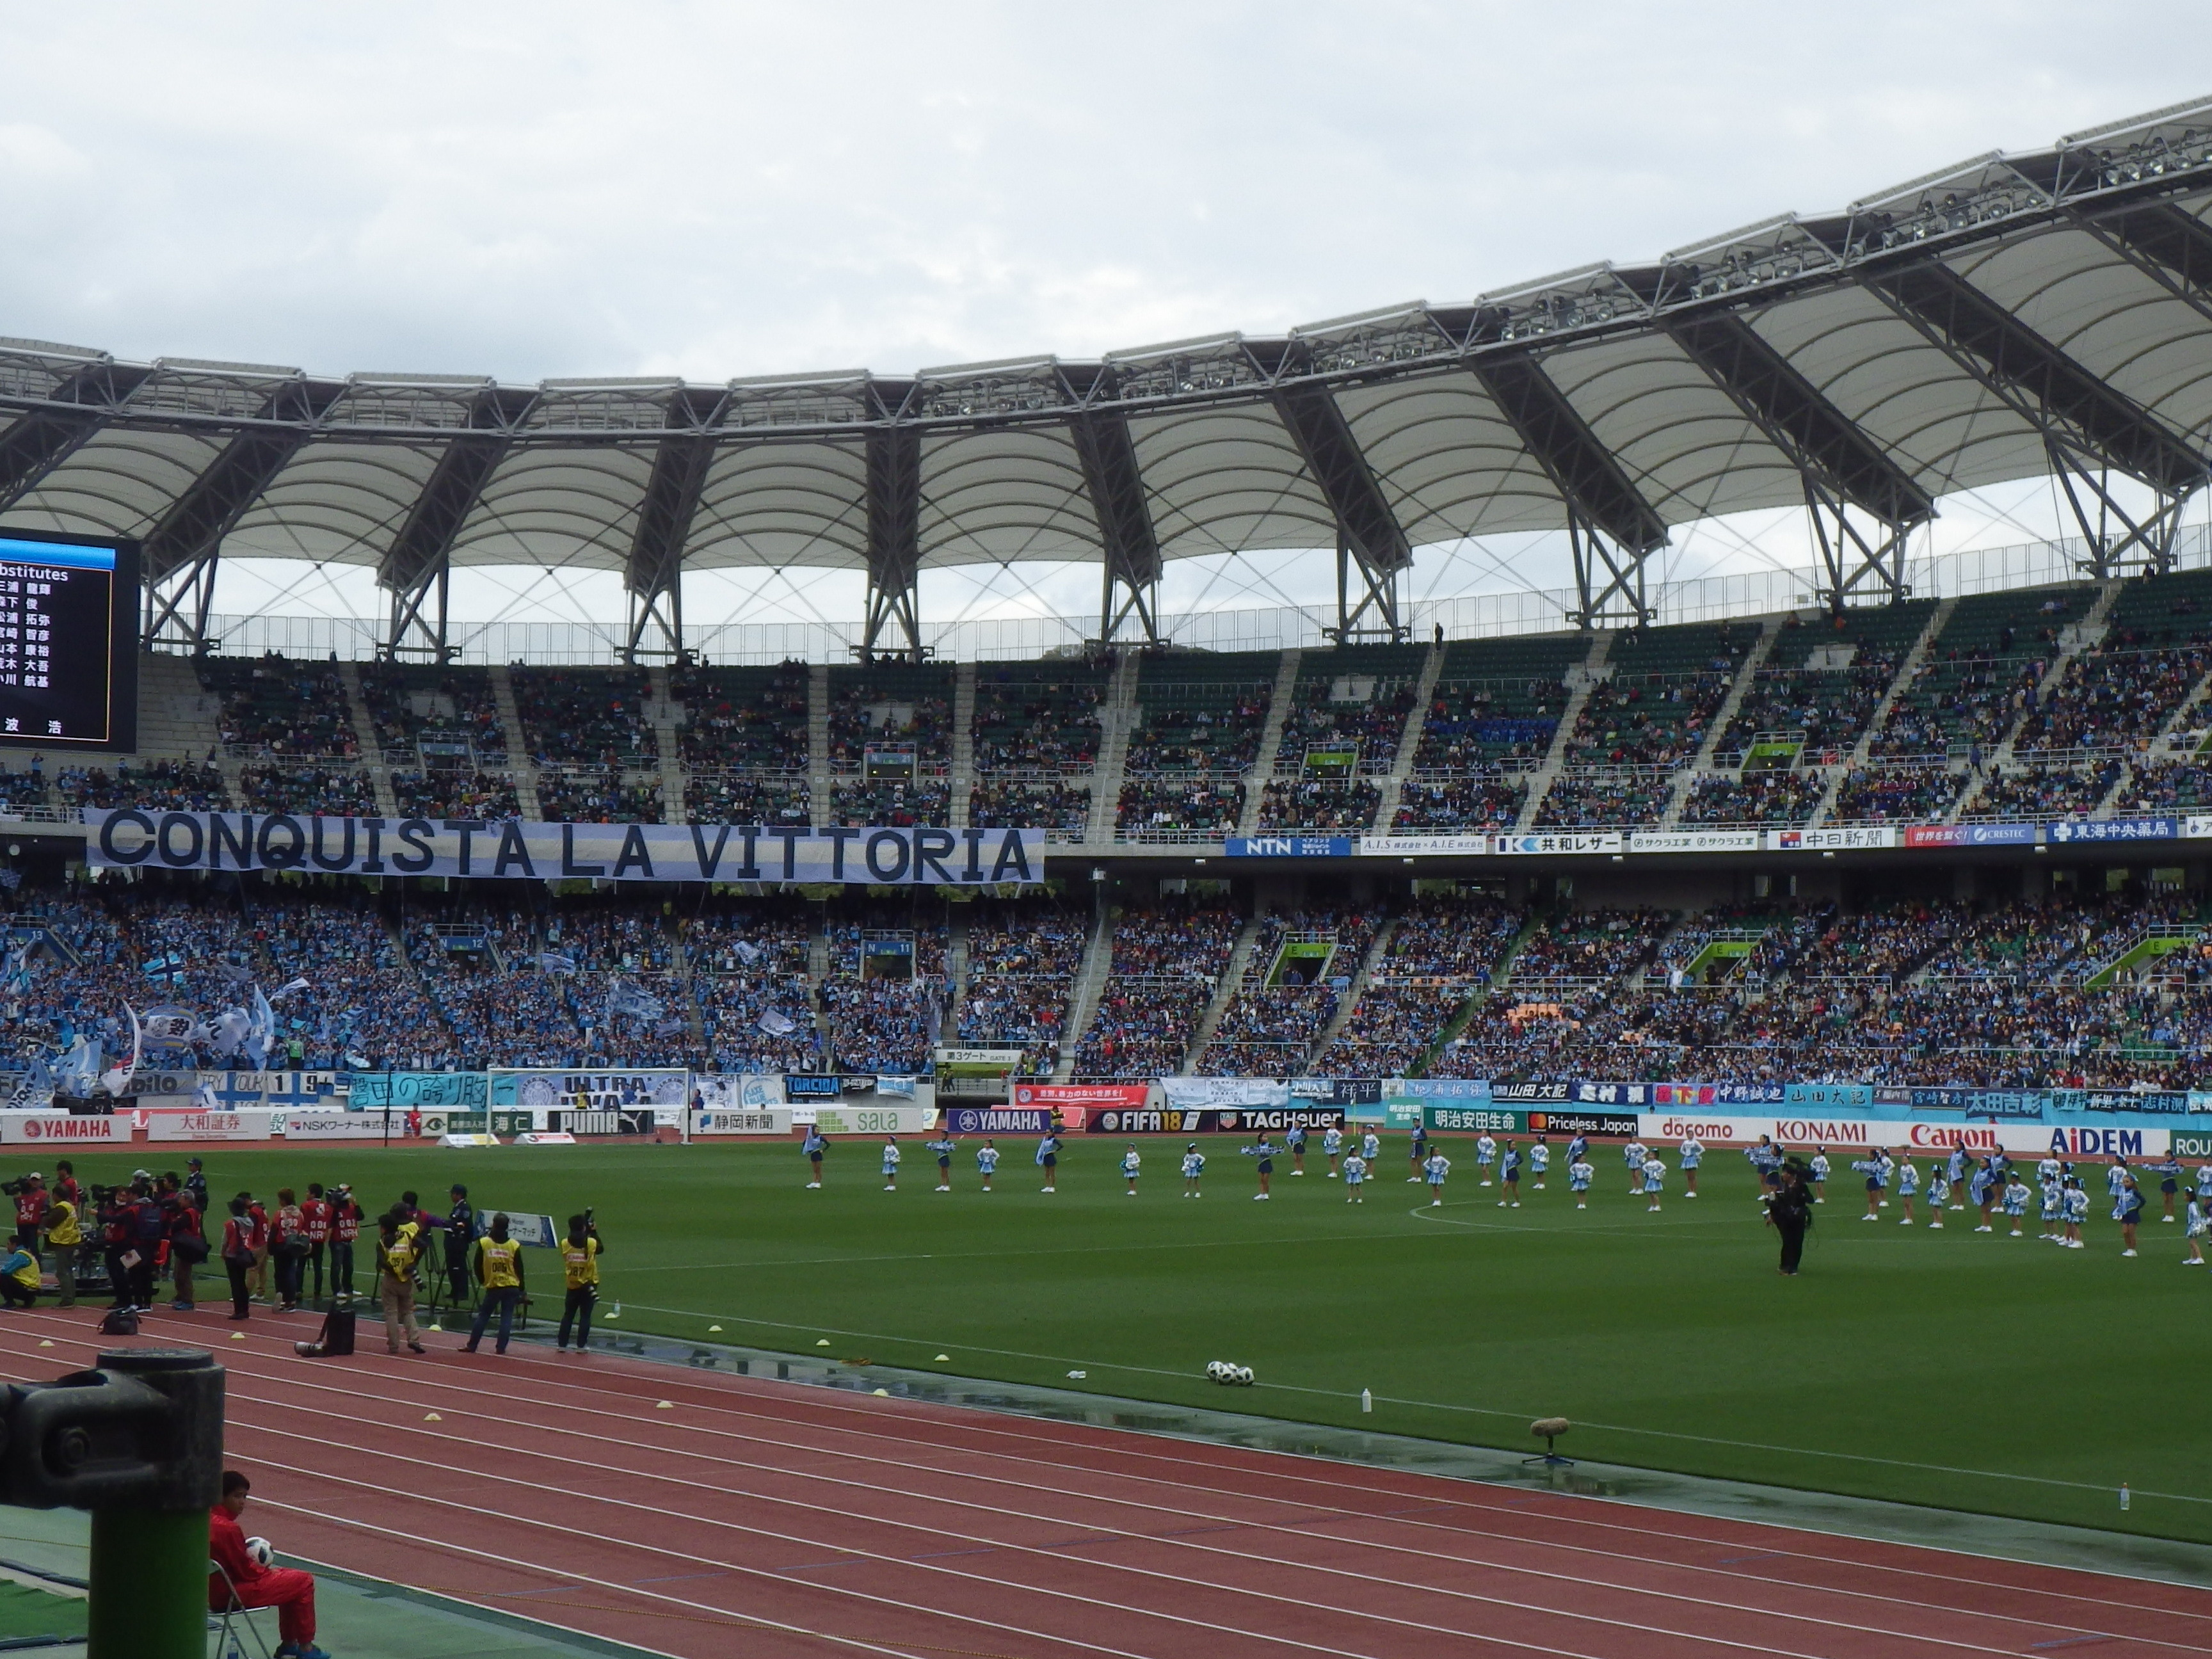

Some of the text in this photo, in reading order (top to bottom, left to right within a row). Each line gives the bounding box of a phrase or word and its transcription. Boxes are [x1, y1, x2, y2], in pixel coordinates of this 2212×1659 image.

[0, 563, 68, 581] bstitutes
[26, 613, 51, 627] 拓弥
[26, 629, 50, 642] 智彦
[25, 645, 49, 657] 康裕
[24, 660, 49, 672] 大吾
[24, 675, 49, 688] 航基
[4, 717, 62, 735] 波 浩
[1987, 830, 2026, 838] CRESTEC
[2074, 822, 2168, 838] 東海中央薬局
[100, 809, 1030, 881] CONQUISTA LA VITTORIA
[1247, 839, 1291, 854] NTN
[1541, 837, 1618, 851] 共和レザー
[1807, 831, 1882, 847] 中日新聞
[32, 931, 43, 940] 13
[472, 939, 483, 948] 12
[868, 944, 910, 952] N 11
[1717, 945, 1723, 954] E
[2154, 942, 2160, 950] E
[947, 1052, 986, 1061] 第3ゲート
[786, 1077, 840, 1093] TORCIDA
[1509, 1084, 1537, 1097] 山田
[1537, 1084, 1567, 1098] 大記
[1720, 1086, 1784, 1102] 中野誠也
[1791, 1089, 1866, 1105] 山田大記
[1389, 1104, 1421, 1113] 明治安田
[1967, 1091, 2041, 1115] 太田吉彰
[44, 1120, 111, 1137] YAMAHA
[180, 1114, 240, 1130] 大和証券
[560, 1111, 619, 1134] PUMA
[714, 1115, 773, 1130] 静岡新聞
[858, 1112, 898, 1131] sala
[979, 1111, 1041, 1130] YAMAHA
[1434, 1110, 1516, 1131] 明治安田生命
[1600, 1118, 1637, 1134] Japan
[1663, 1118, 1733, 1138] docomo
[1776, 1121, 1867, 1142] KONAMI
[1911, 1124, 1995, 1148] Canon
[2050, 1128, 2142, 1155] AiDEM
[2176, 1139, 2212, 1155] ROU
